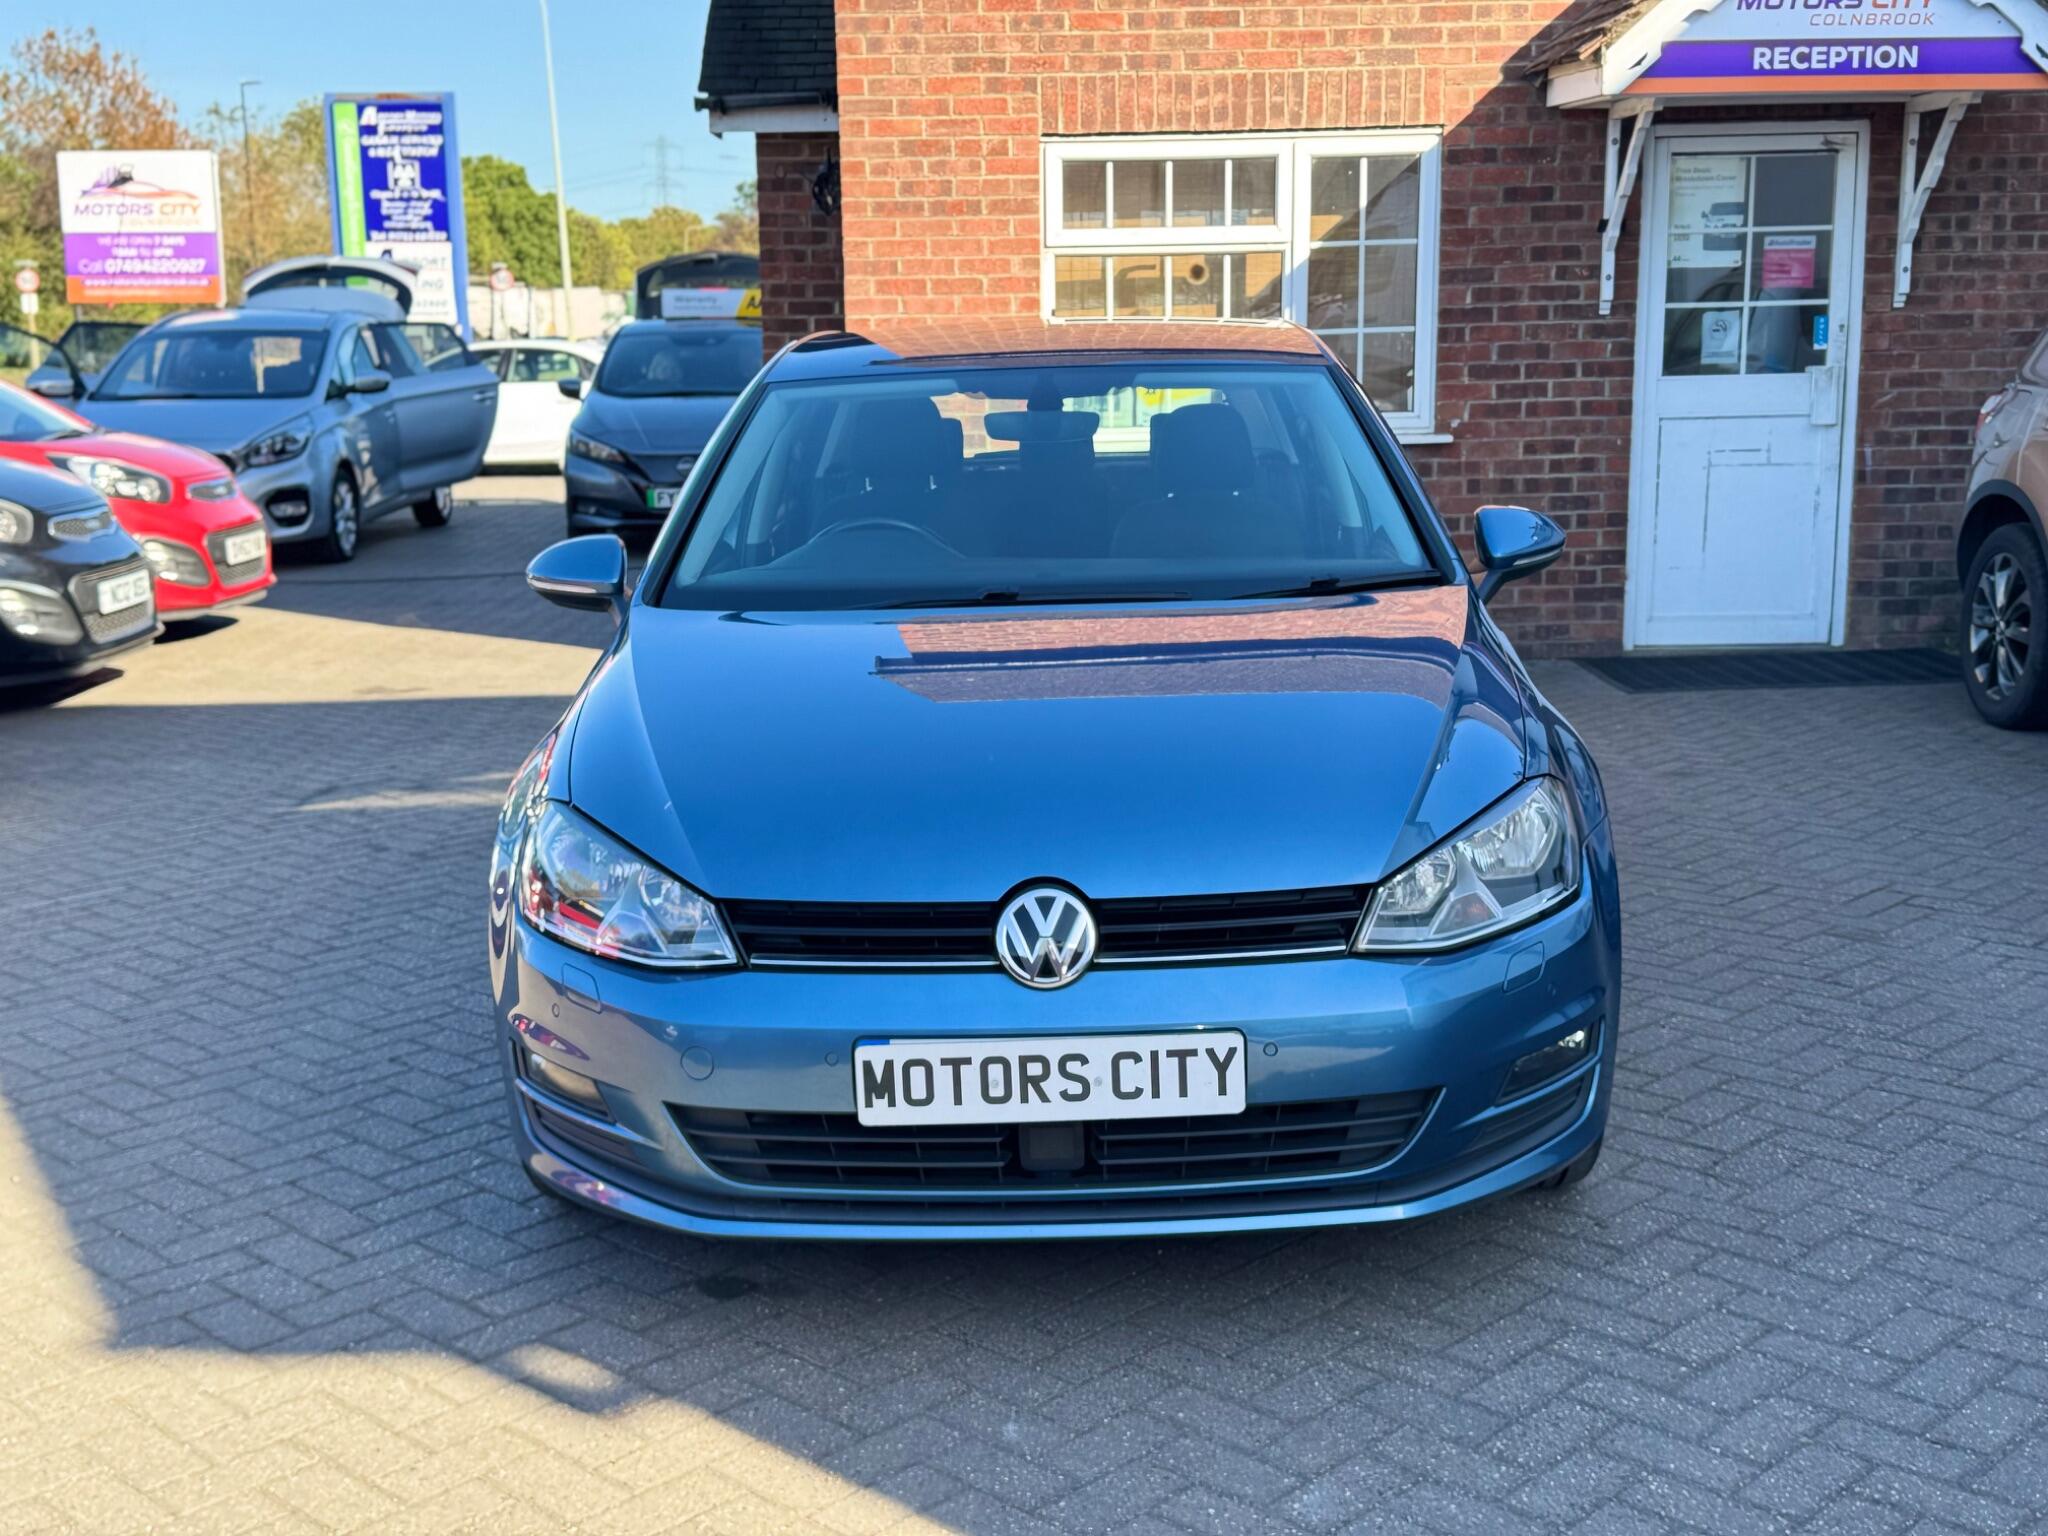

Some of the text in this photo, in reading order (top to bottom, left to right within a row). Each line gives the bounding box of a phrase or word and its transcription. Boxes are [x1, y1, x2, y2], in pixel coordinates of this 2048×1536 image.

[1809, 12, 1935, 26] COLNBROOK
[1752, 45, 1919, 70] RECEPTION
[74, 203, 201, 216] MOTORS CITY
[862, 1046, 1237, 1109] MOTORS CITY
